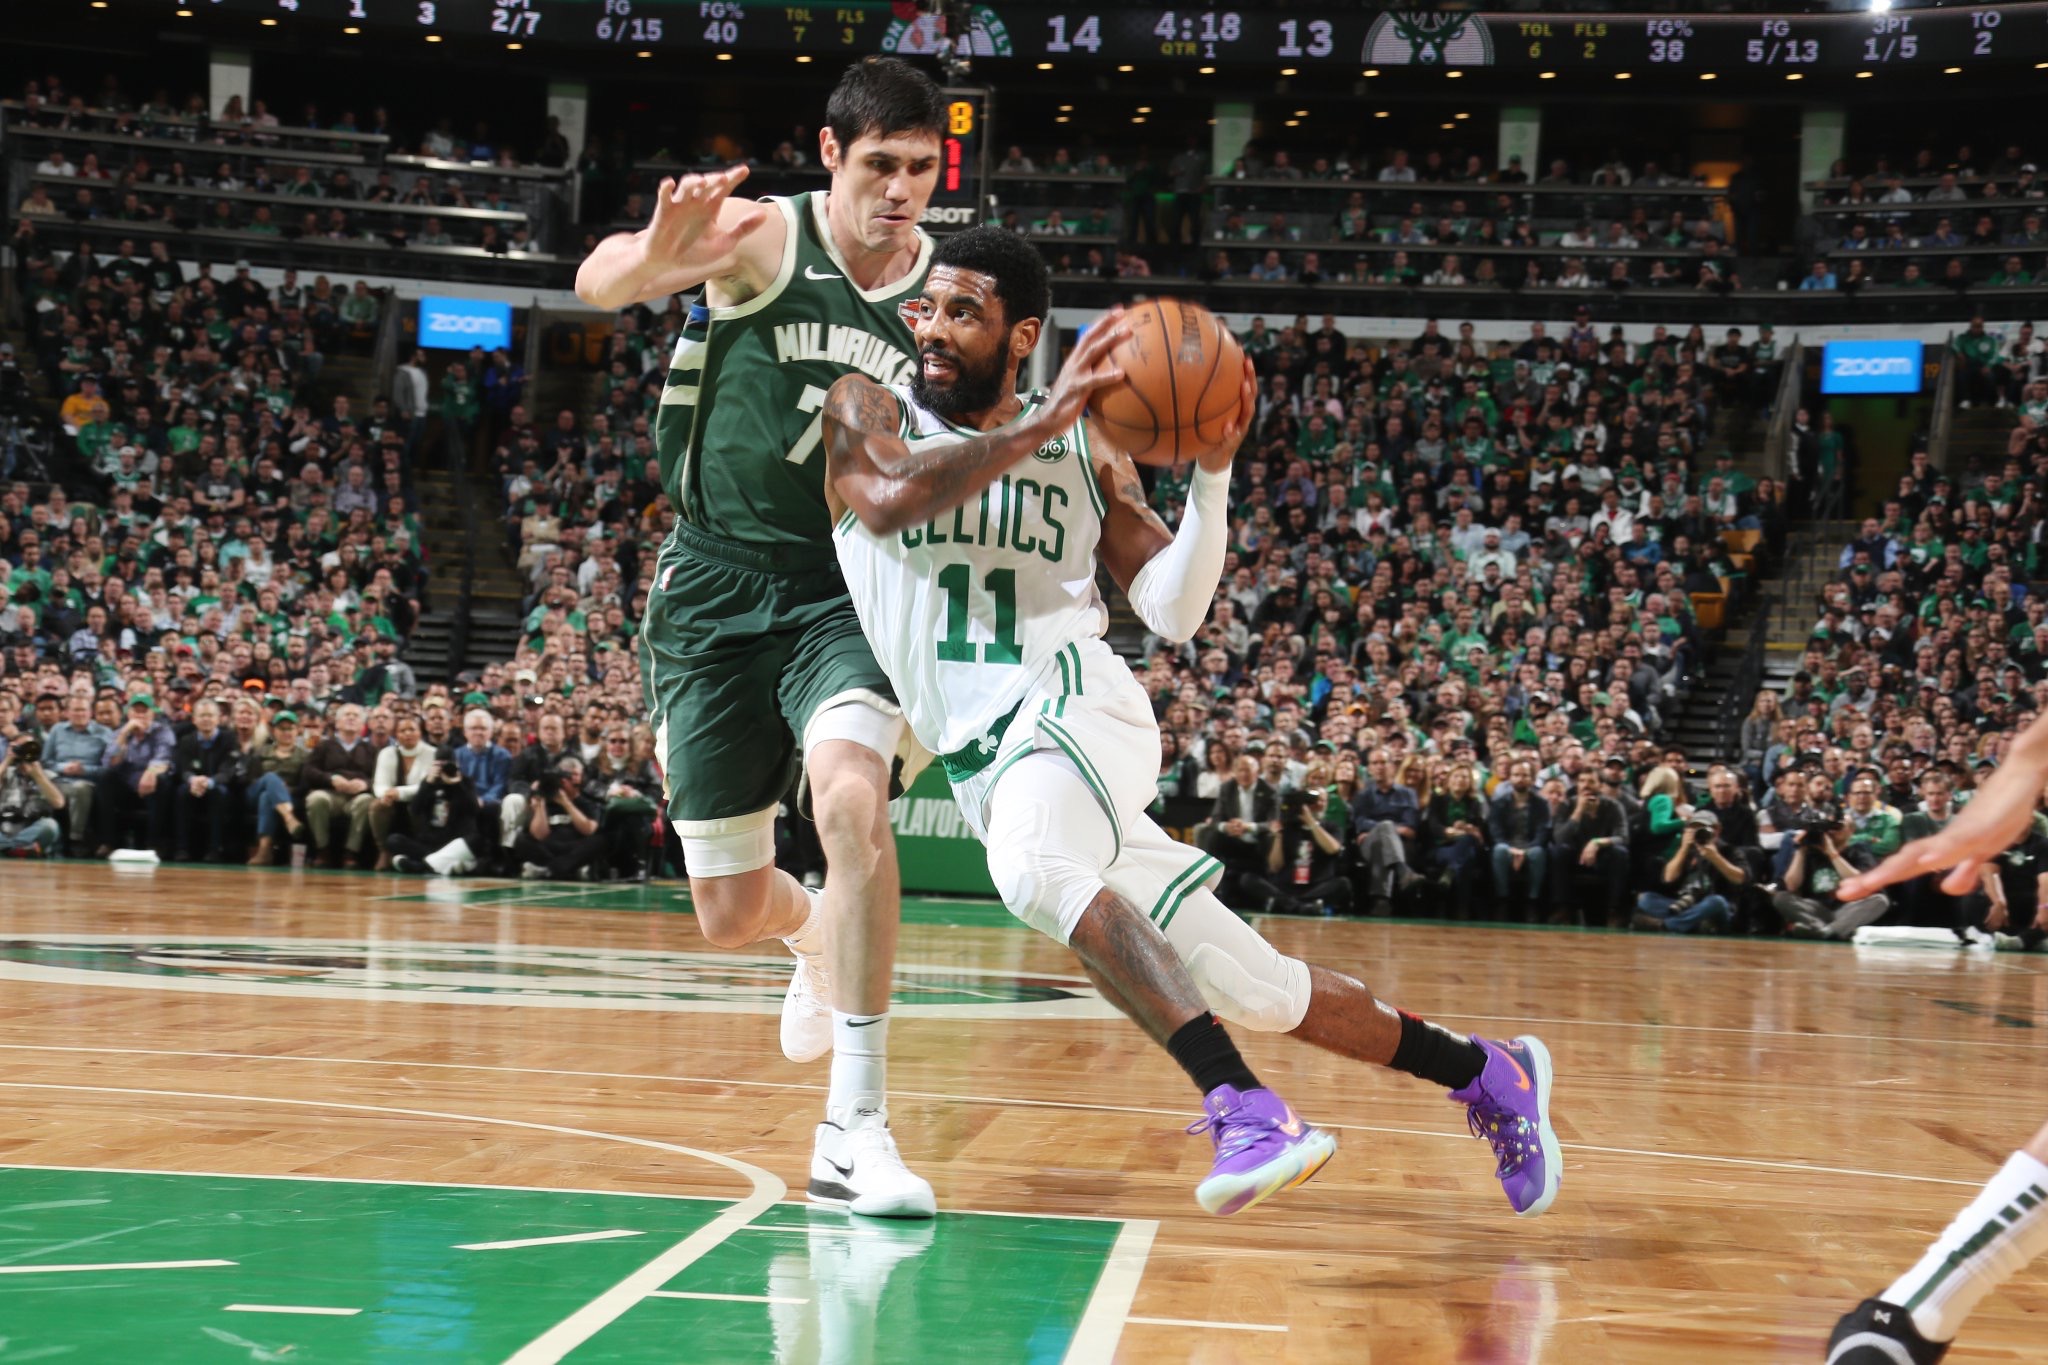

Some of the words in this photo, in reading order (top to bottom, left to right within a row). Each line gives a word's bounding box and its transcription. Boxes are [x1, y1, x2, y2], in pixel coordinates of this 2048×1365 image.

[417, 1, 436, 25] 3
[605, 0, 631, 15] FG
[700, 2, 745, 19] FG%
[785, 8, 813, 22] TOL
[837, 9, 865, 23] FLS
[1970, 10, 2001, 29] TO
[491, 8, 541, 35] 2/7
[596, 17, 663, 43] 6/15
[703, 20, 738, 44] 40
[1046, 14, 1101, 53] 14
[1153, 11, 1241, 42] 4:18
[1519, 22, 1552, 37] TOL
[1574, 23, 1607, 37] FLS
[1646, 20, 1694, 37] FG%
[1762, 20, 1790, 37] FG
[1873, 16, 1912, 34] 3PT
[792, 26, 806, 43] 7
[841, 27, 854, 44] 3
[1277, 19, 1334, 57] 13
[1974, 31, 1993, 55] 2
[1161, 42, 1197, 55] QTR
[1204, 43, 1216, 59] 1
[1529, 42, 1541, 58] 6
[1583, 42, 1596, 58] 2
[1650, 39, 1685, 63] 38
[1746, 39, 1819, 65] 5/13
[1863, 35, 1918, 61] 1/5
[427, 312, 503, 336] zoom
[773, 322, 919, 386] MILWAUKE
[1832, 357, 1913, 377] zoom
[785, 383, 828, 466] 7
[936, 563, 1024, 666] 11
